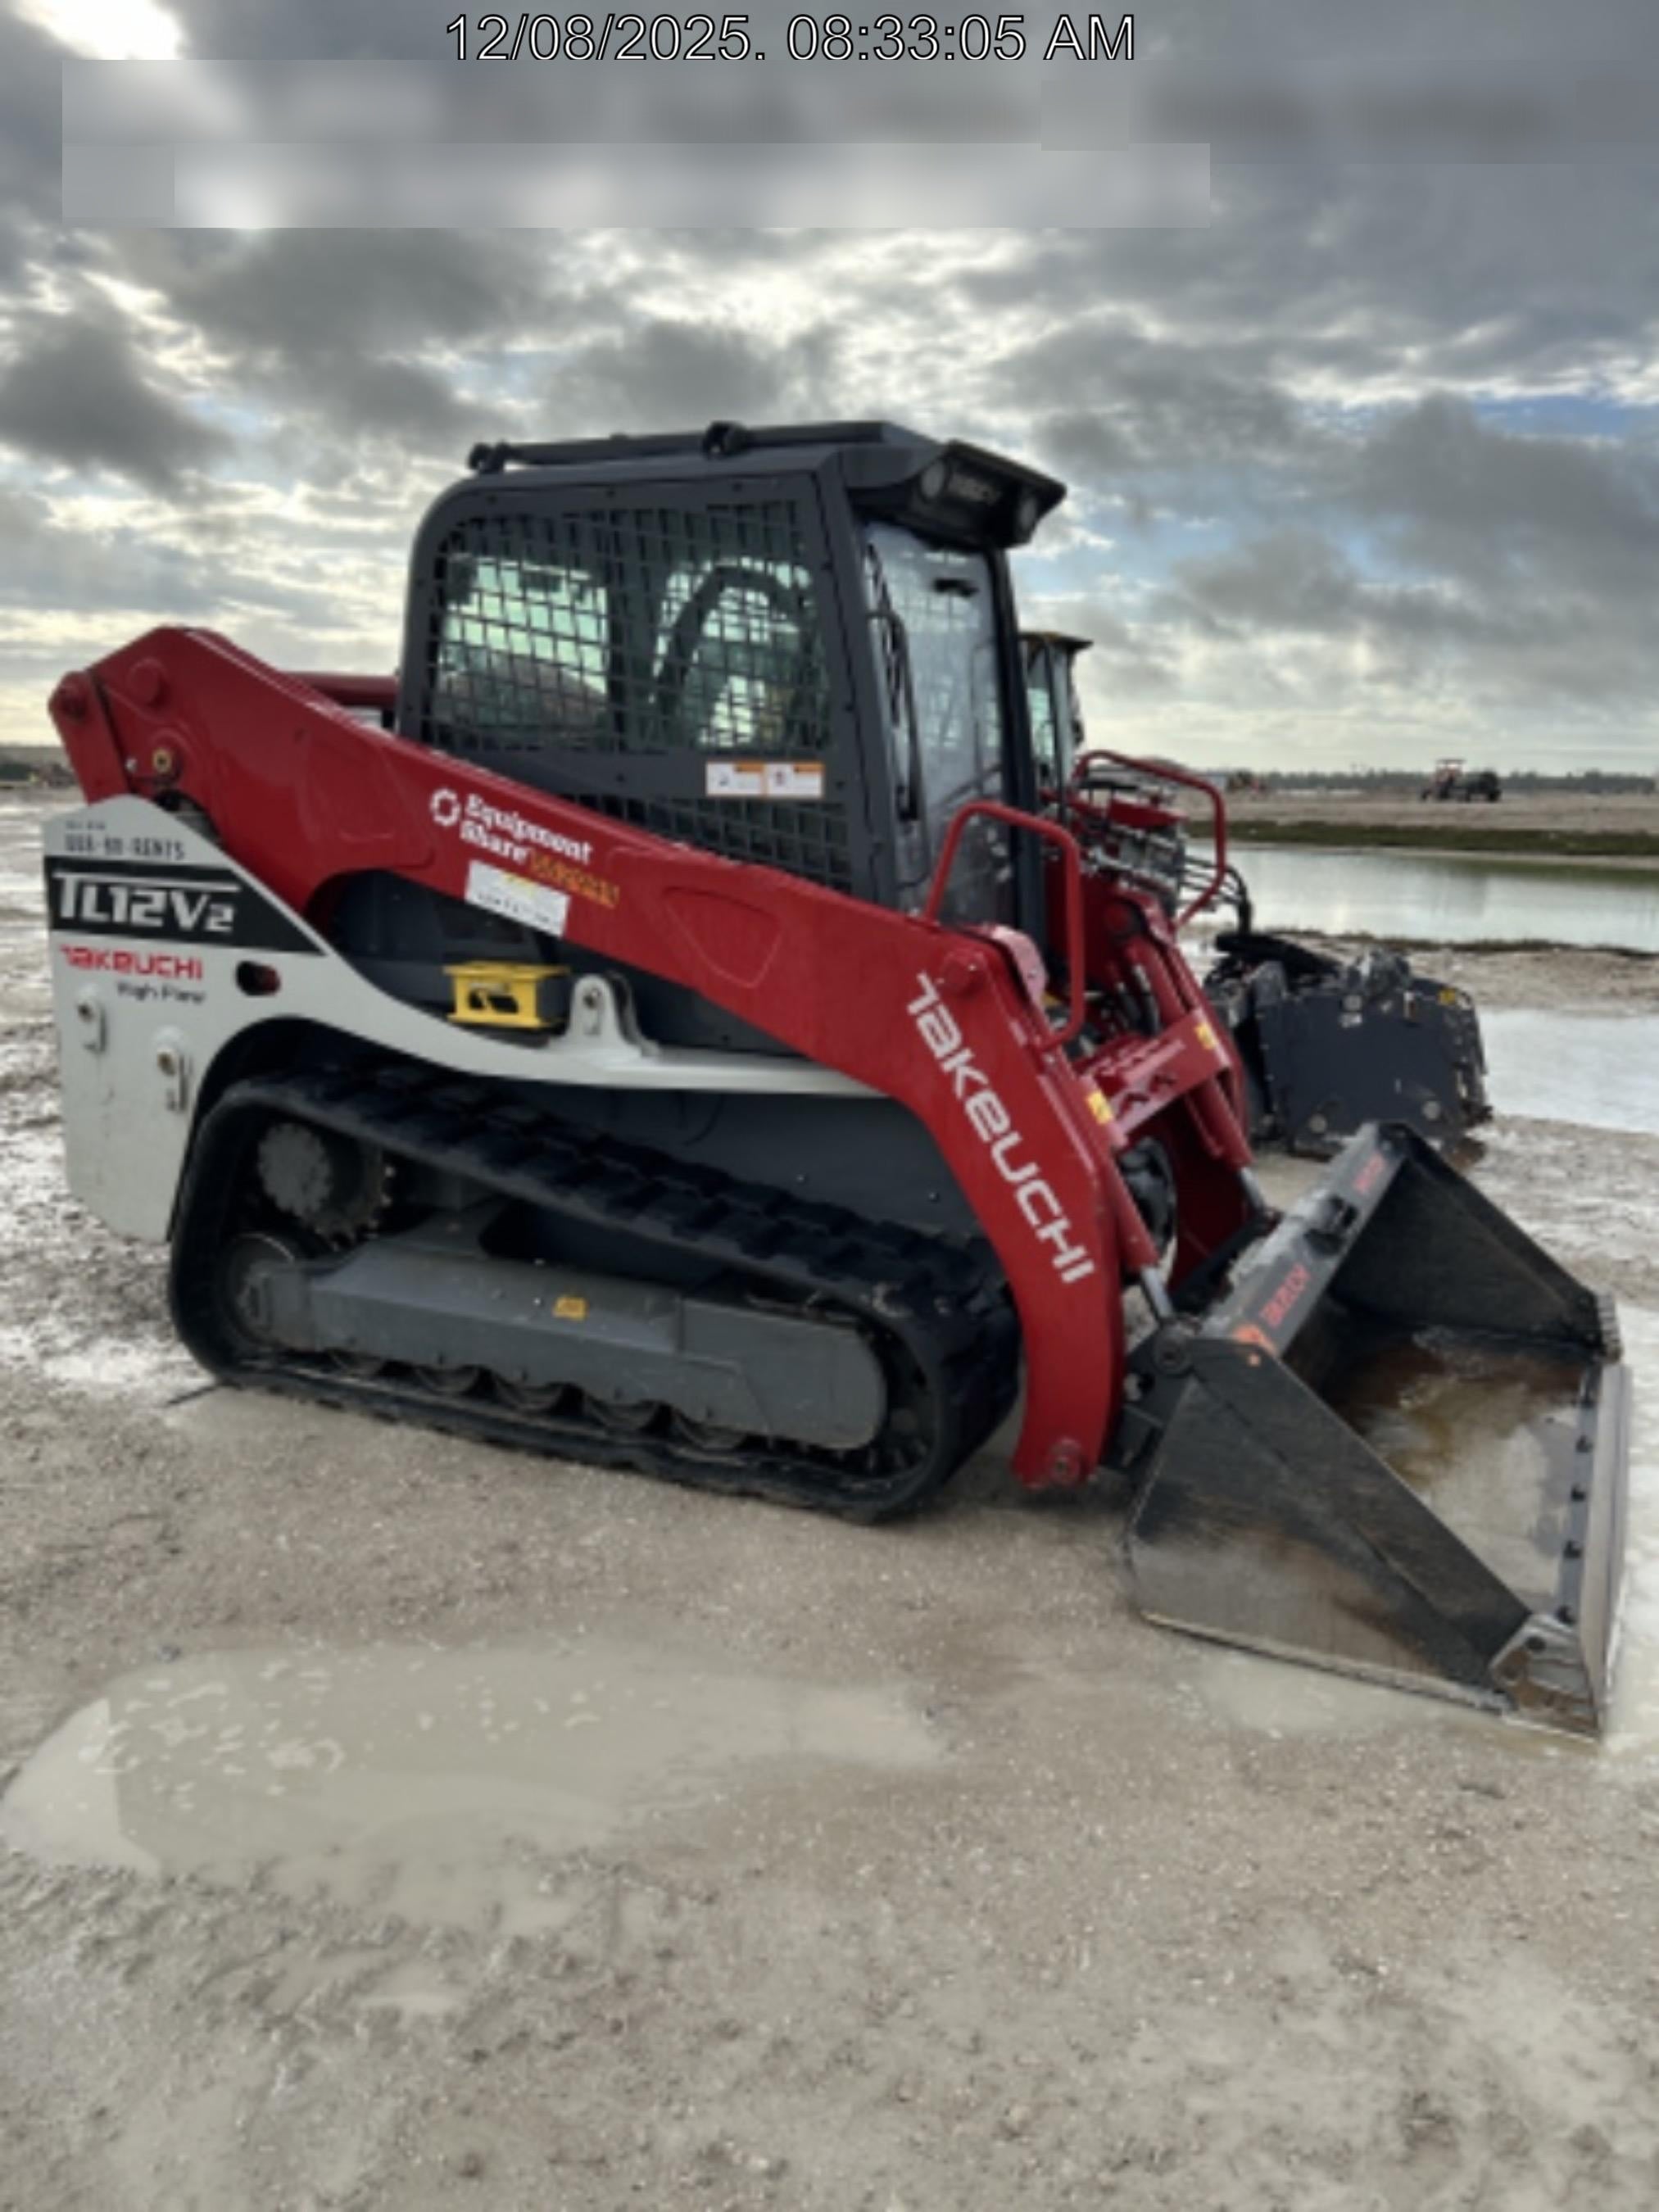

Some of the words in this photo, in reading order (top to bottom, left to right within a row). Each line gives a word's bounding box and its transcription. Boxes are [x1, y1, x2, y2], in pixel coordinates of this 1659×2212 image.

[465, 793, 592, 865] Equipment
[52, 871, 241, 932] TL12V2
[907, 972, 1095, 1284] TAKEUCHI
